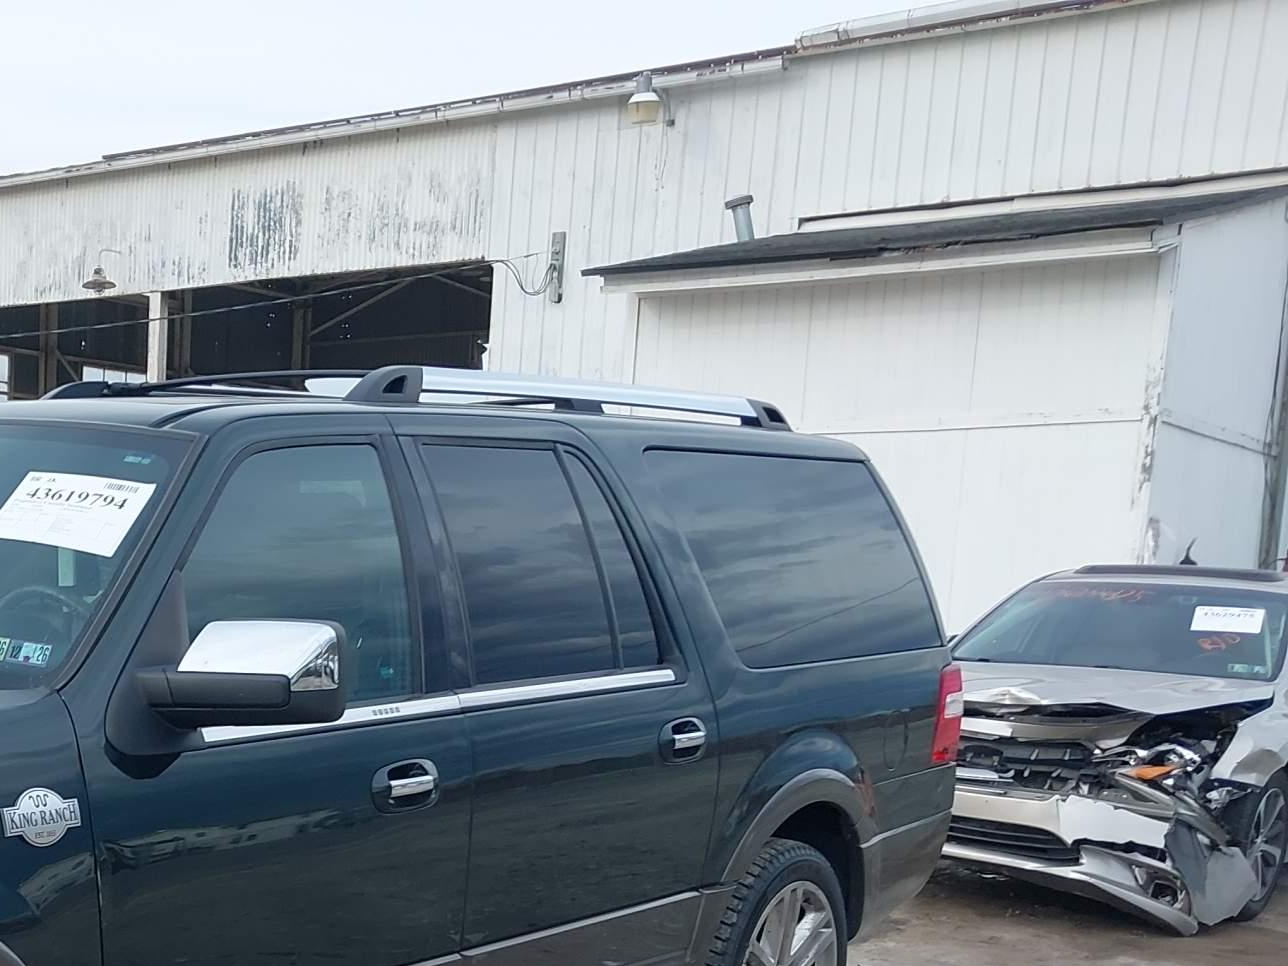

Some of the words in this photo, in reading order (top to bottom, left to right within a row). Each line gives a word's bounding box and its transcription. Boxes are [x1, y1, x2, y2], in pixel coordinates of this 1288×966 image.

[26, 487, 128, 510] 43619794
[10, 645, 22, 659] 12
[36, 645, 49, 663] 26
[7, 811, 38, 830] KING
[39, 803, 78, 826] RANCH
